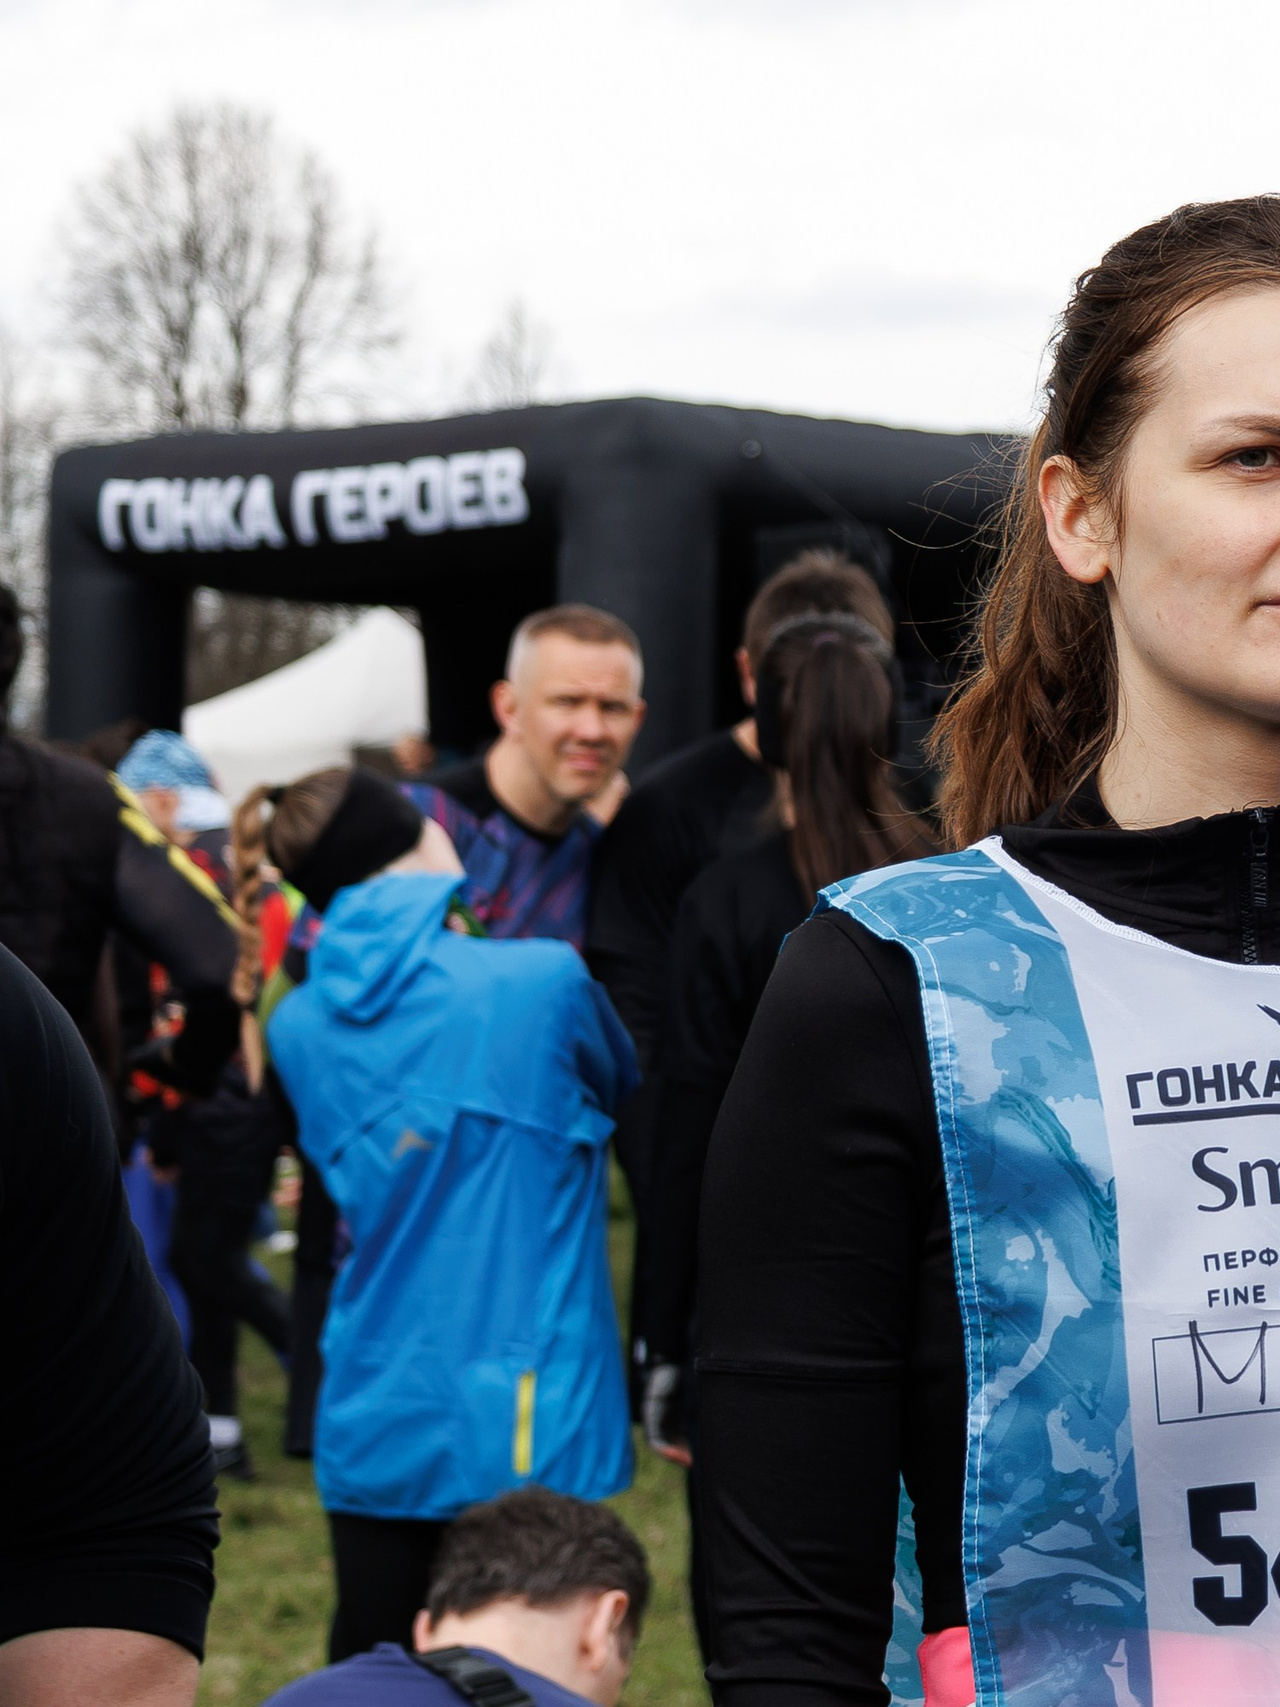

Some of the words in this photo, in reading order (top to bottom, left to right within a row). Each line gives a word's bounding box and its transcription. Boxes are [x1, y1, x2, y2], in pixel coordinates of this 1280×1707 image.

[100, 474, 287, 552] ГОНКА
[291, 446, 529, 547] ГЕРОЕВ
[1207, 1284, 1267, 1308] FINE
